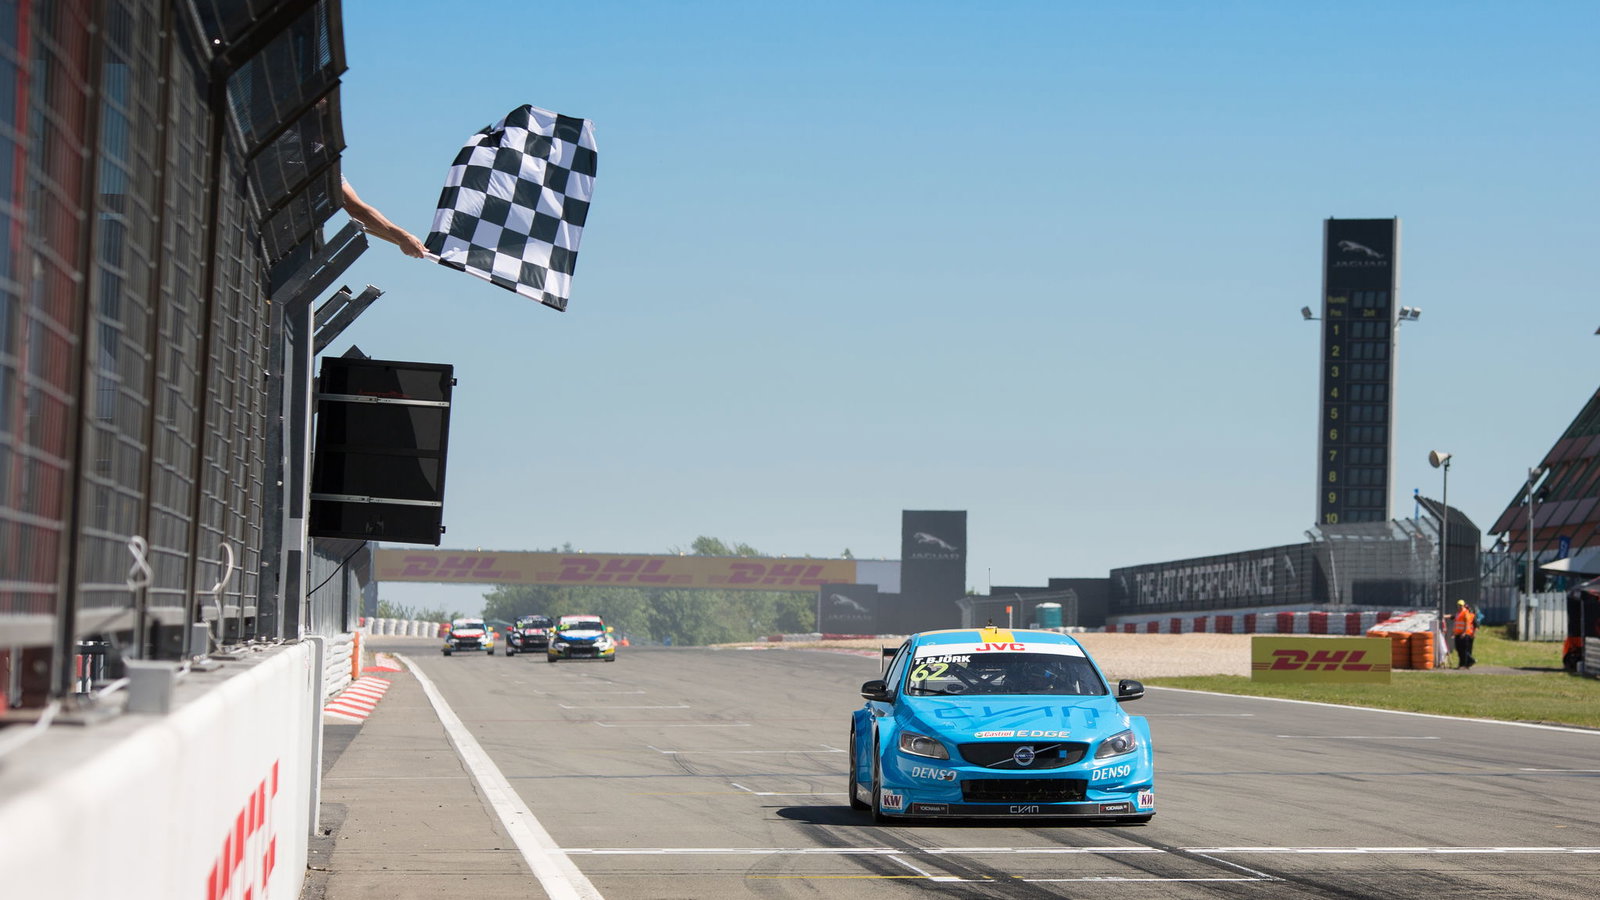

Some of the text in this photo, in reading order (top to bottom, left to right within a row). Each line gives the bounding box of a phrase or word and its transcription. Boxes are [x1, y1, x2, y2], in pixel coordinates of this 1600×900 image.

[1334, 324, 1339, 336] 1
[1332, 345, 1340, 357] 2
[1331, 366, 1339, 378] 3
[1331, 387, 1338, 398] 4
[1331, 408, 1338, 419] 5
[1330, 429, 1337, 440] 6
[1329, 450, 1337, 461] 7
[1328, 471, 1336, 482] 8
[1328, 492, 1336, 503] 9
[1325, 513, 1338, 524] 10
[401, 556, 501, 576] DHL
[557, 558, 672, 582] DHL
[728, 563, 829, 585] DHL
[1136, 557, 1275, 605] THE ART OF PERFORMANCE
[976, 643, 1025, 651] JVC
[914, 655, 971, 665] T.BJÖRK
[1270, 650, 1373, 671] DHL
[911, 663, 949, 682] 62
[1016, 730, 1071, 738] EDGE
[912, 766, 957, 782] DENSO
[1092, 765, 1131, 781] DENSO
[884, 795, 901, 807] KW
[1141, 794, 1153, 805] KW
[1010, 805, 1039, 814] CYAN
